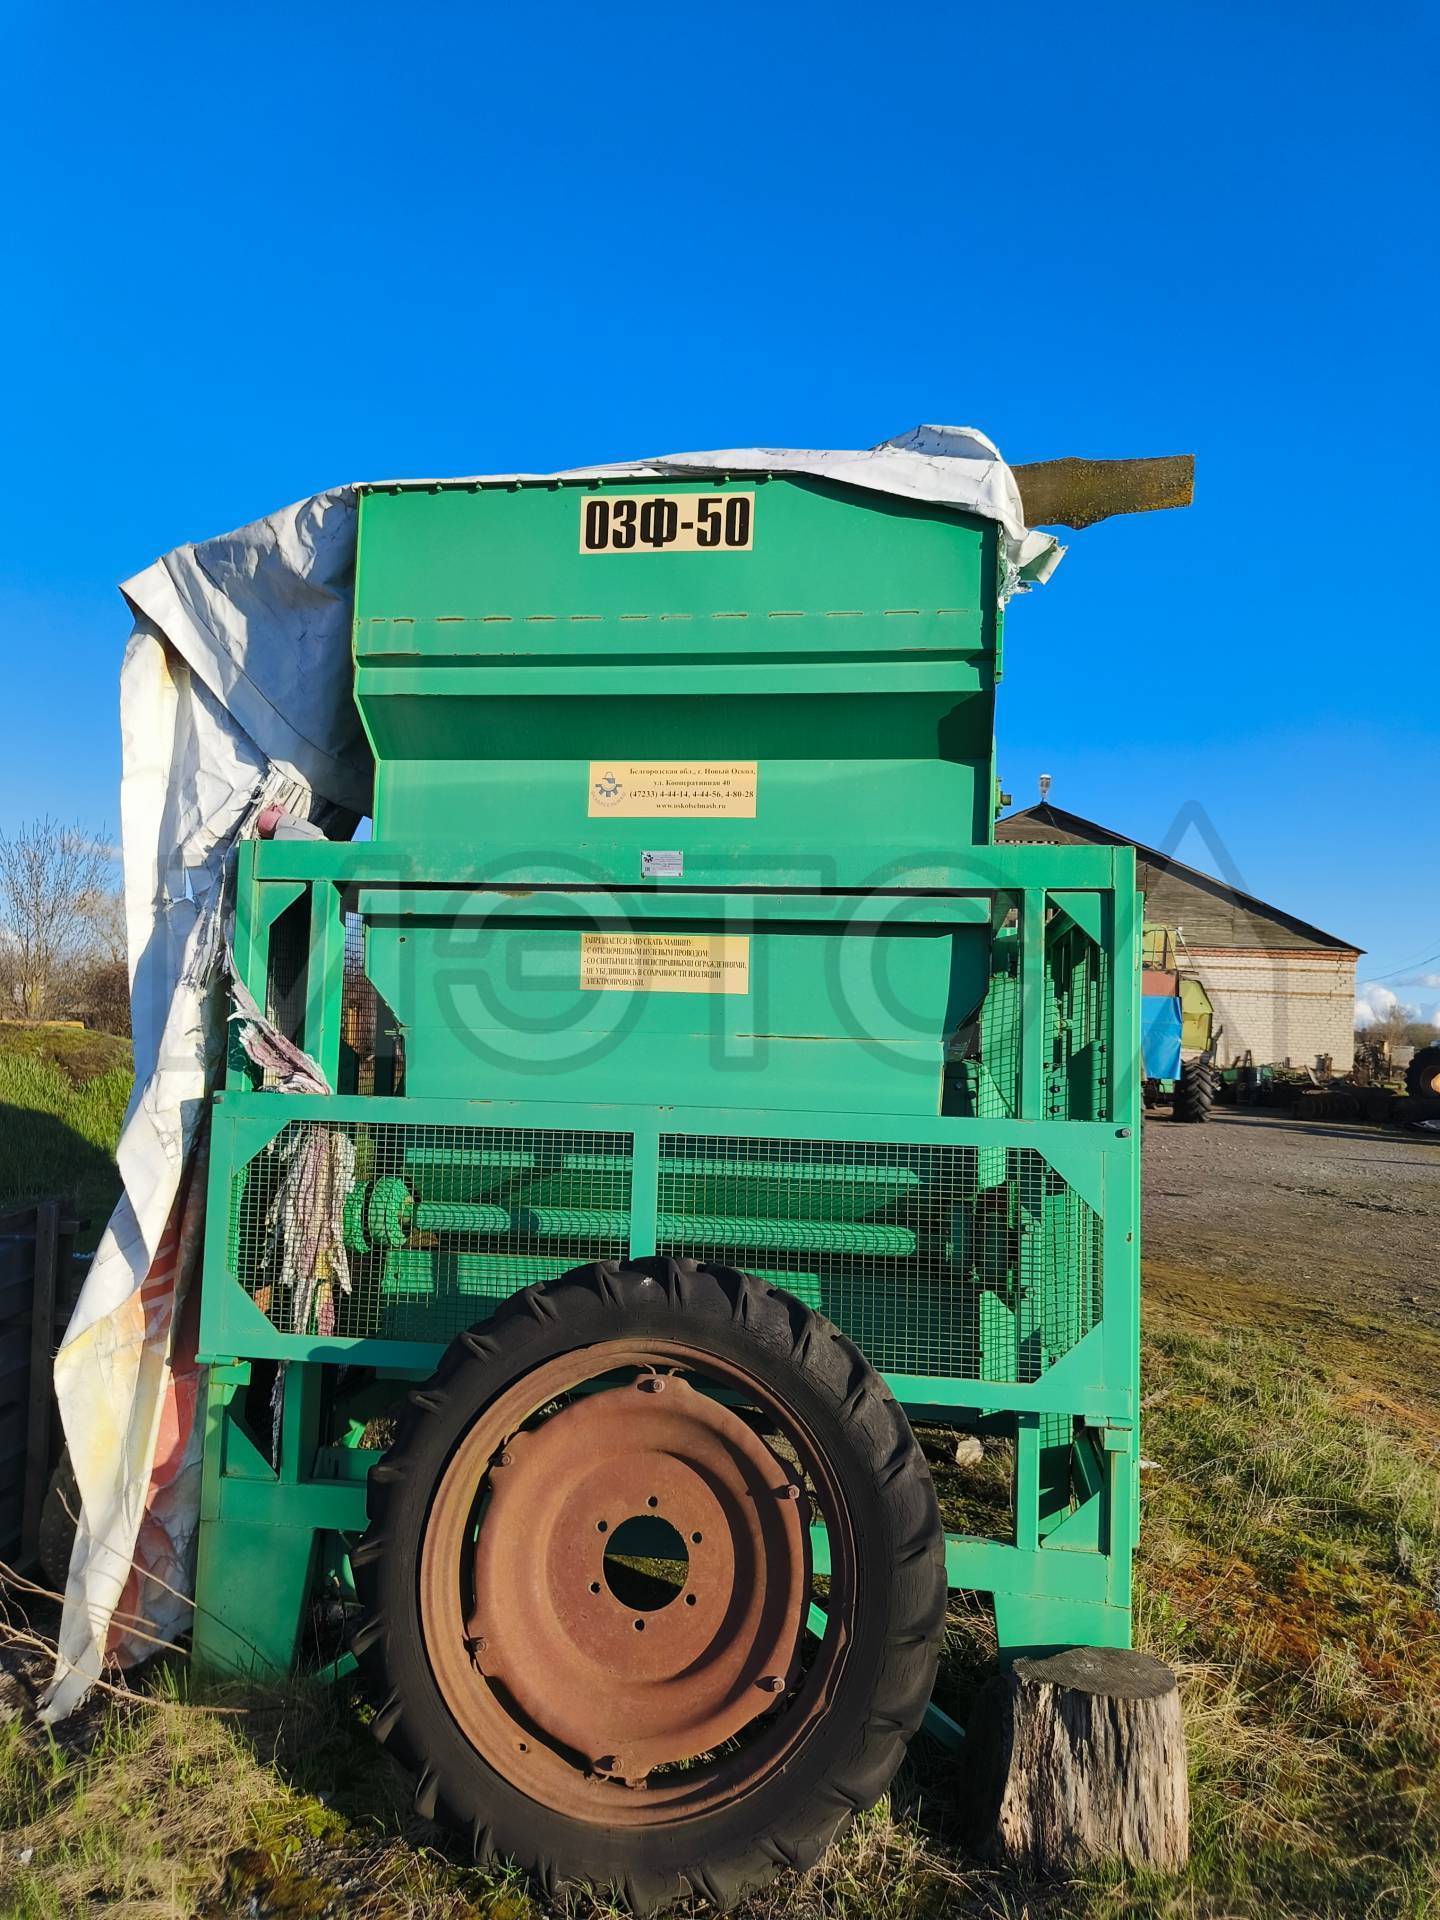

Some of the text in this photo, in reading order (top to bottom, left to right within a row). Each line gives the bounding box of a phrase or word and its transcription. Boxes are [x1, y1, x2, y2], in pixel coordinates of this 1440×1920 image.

[585, 497, 750, 549] ОЗФ-50
[704, 767, 730, 775] Новый
[629, 790, 658, 799] (47233)
[659, 790, 691, 799] 4-44-14,
[692, 790, 724, 799] 4-44-56,
[725, 790, 754, 798] 4-80-28
[629, 937, 663, 946] ЗАПУСКАТЬ
